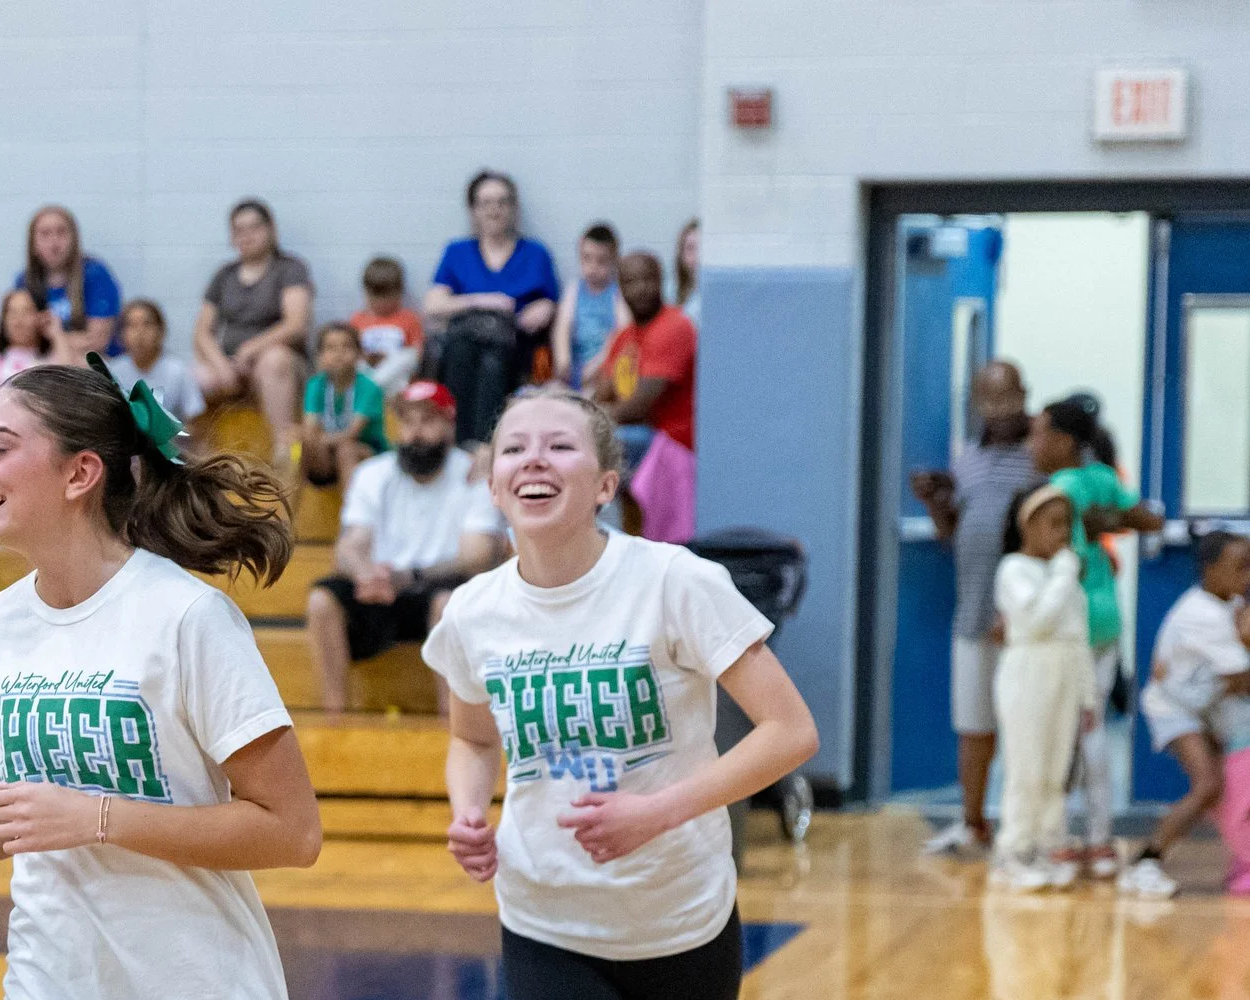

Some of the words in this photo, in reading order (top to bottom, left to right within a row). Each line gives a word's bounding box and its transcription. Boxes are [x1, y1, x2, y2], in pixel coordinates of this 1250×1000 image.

[506, 643, 576, 673] Waterford
[577, 639, 627, 664] United
[1, 669, 69, 700] Waterford
[64, 669, 115, 695] United
